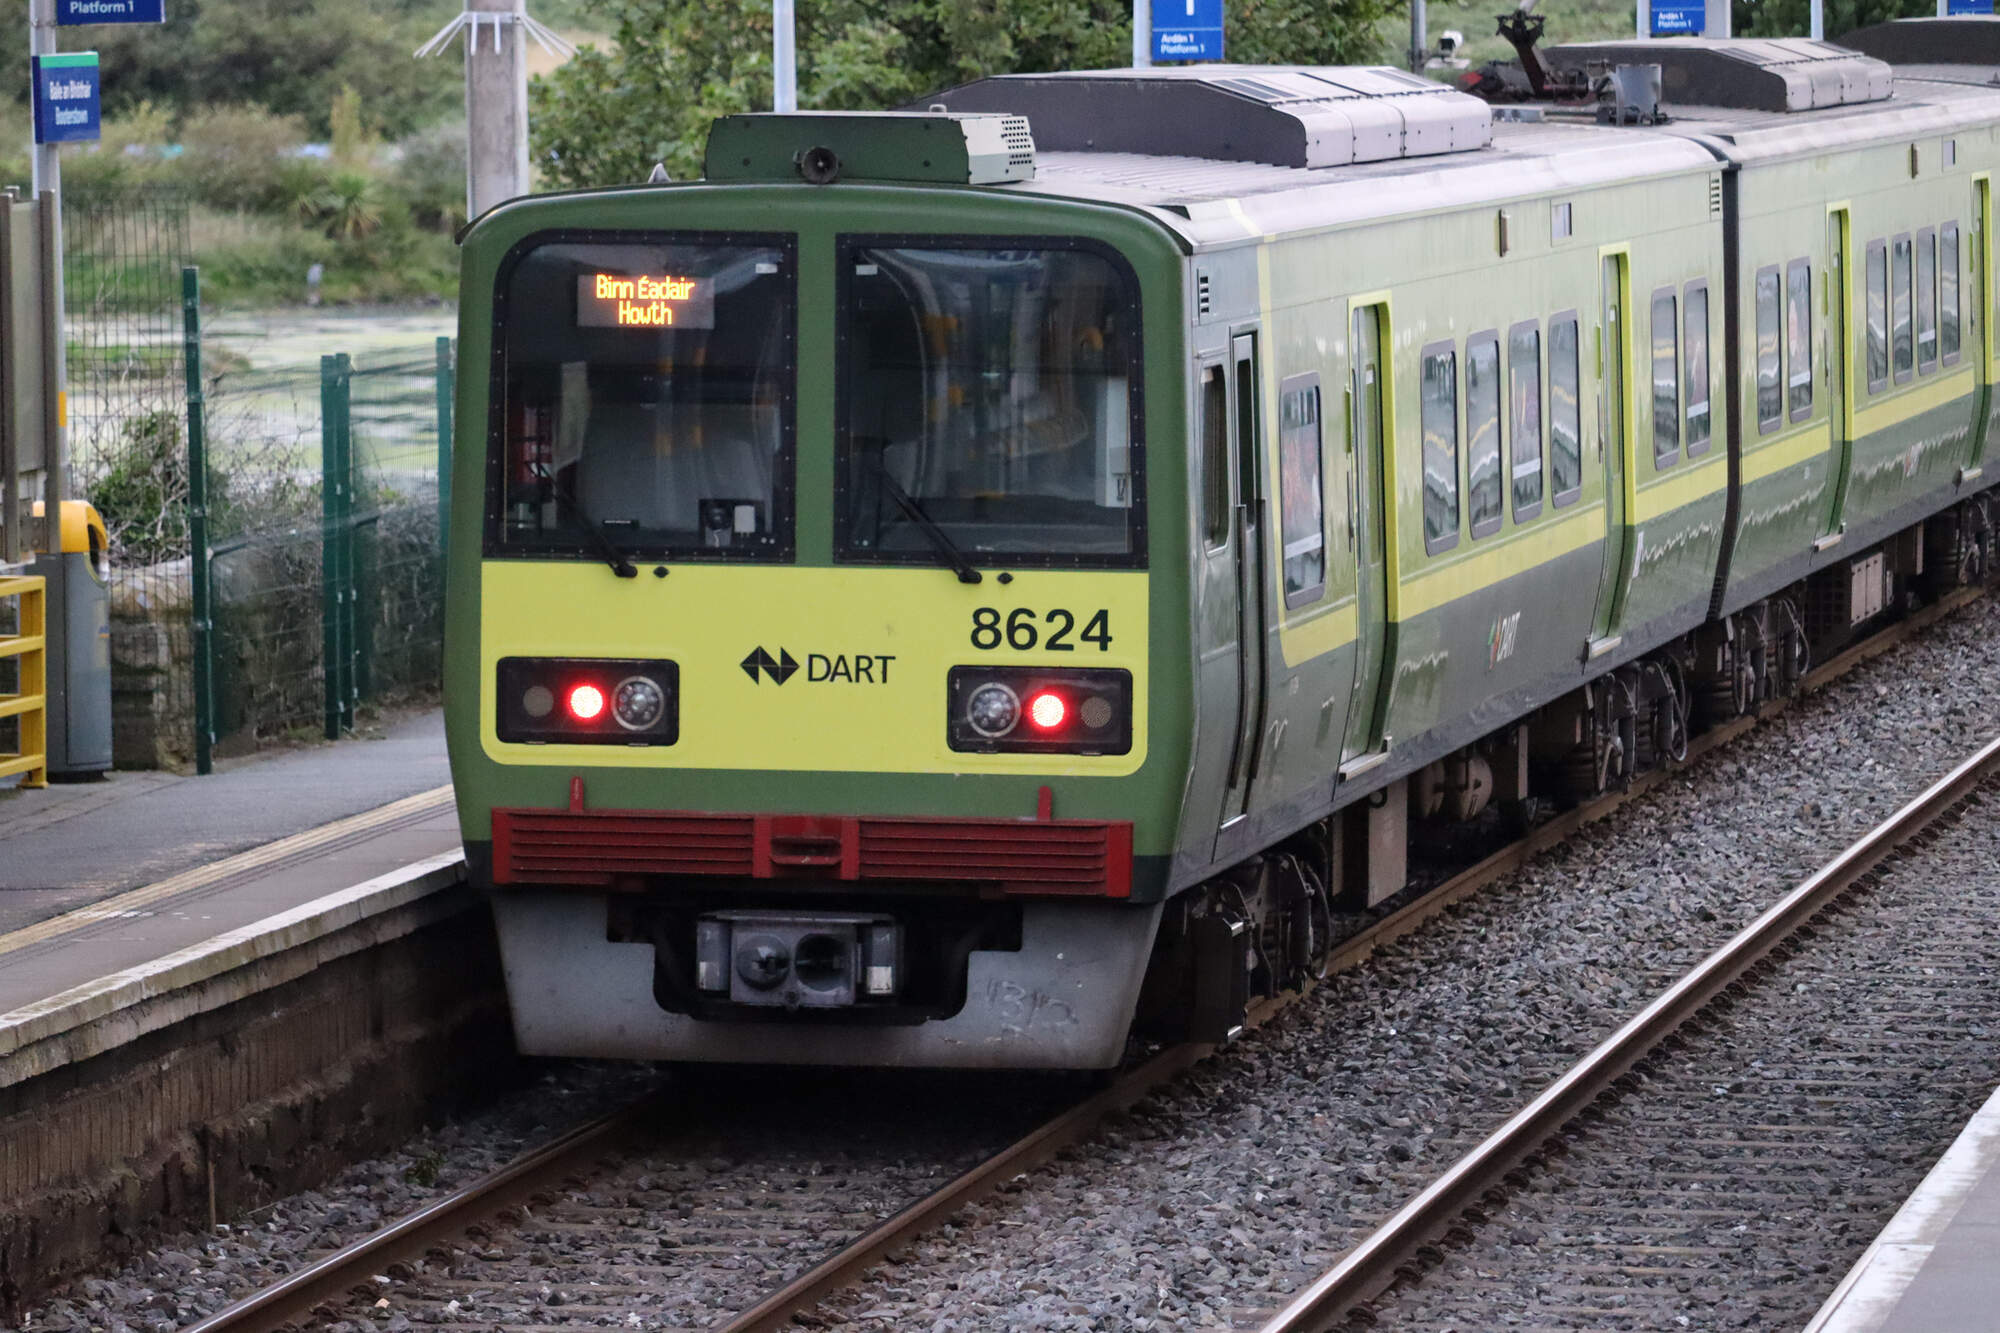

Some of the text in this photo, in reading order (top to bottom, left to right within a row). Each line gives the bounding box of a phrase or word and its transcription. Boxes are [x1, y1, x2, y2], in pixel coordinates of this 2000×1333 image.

[70, 1, 134, 14] Platform 1
[1161, 43, 1205, 54] Platform 1
[1189, 33, 1195, 43] 1
[596, 274, 695, 300] Binn Éadair
[619, 300, 672, 325] Howth
[970, 607, 1113, 651] 8624
[807, 653, 896, 684] DART
